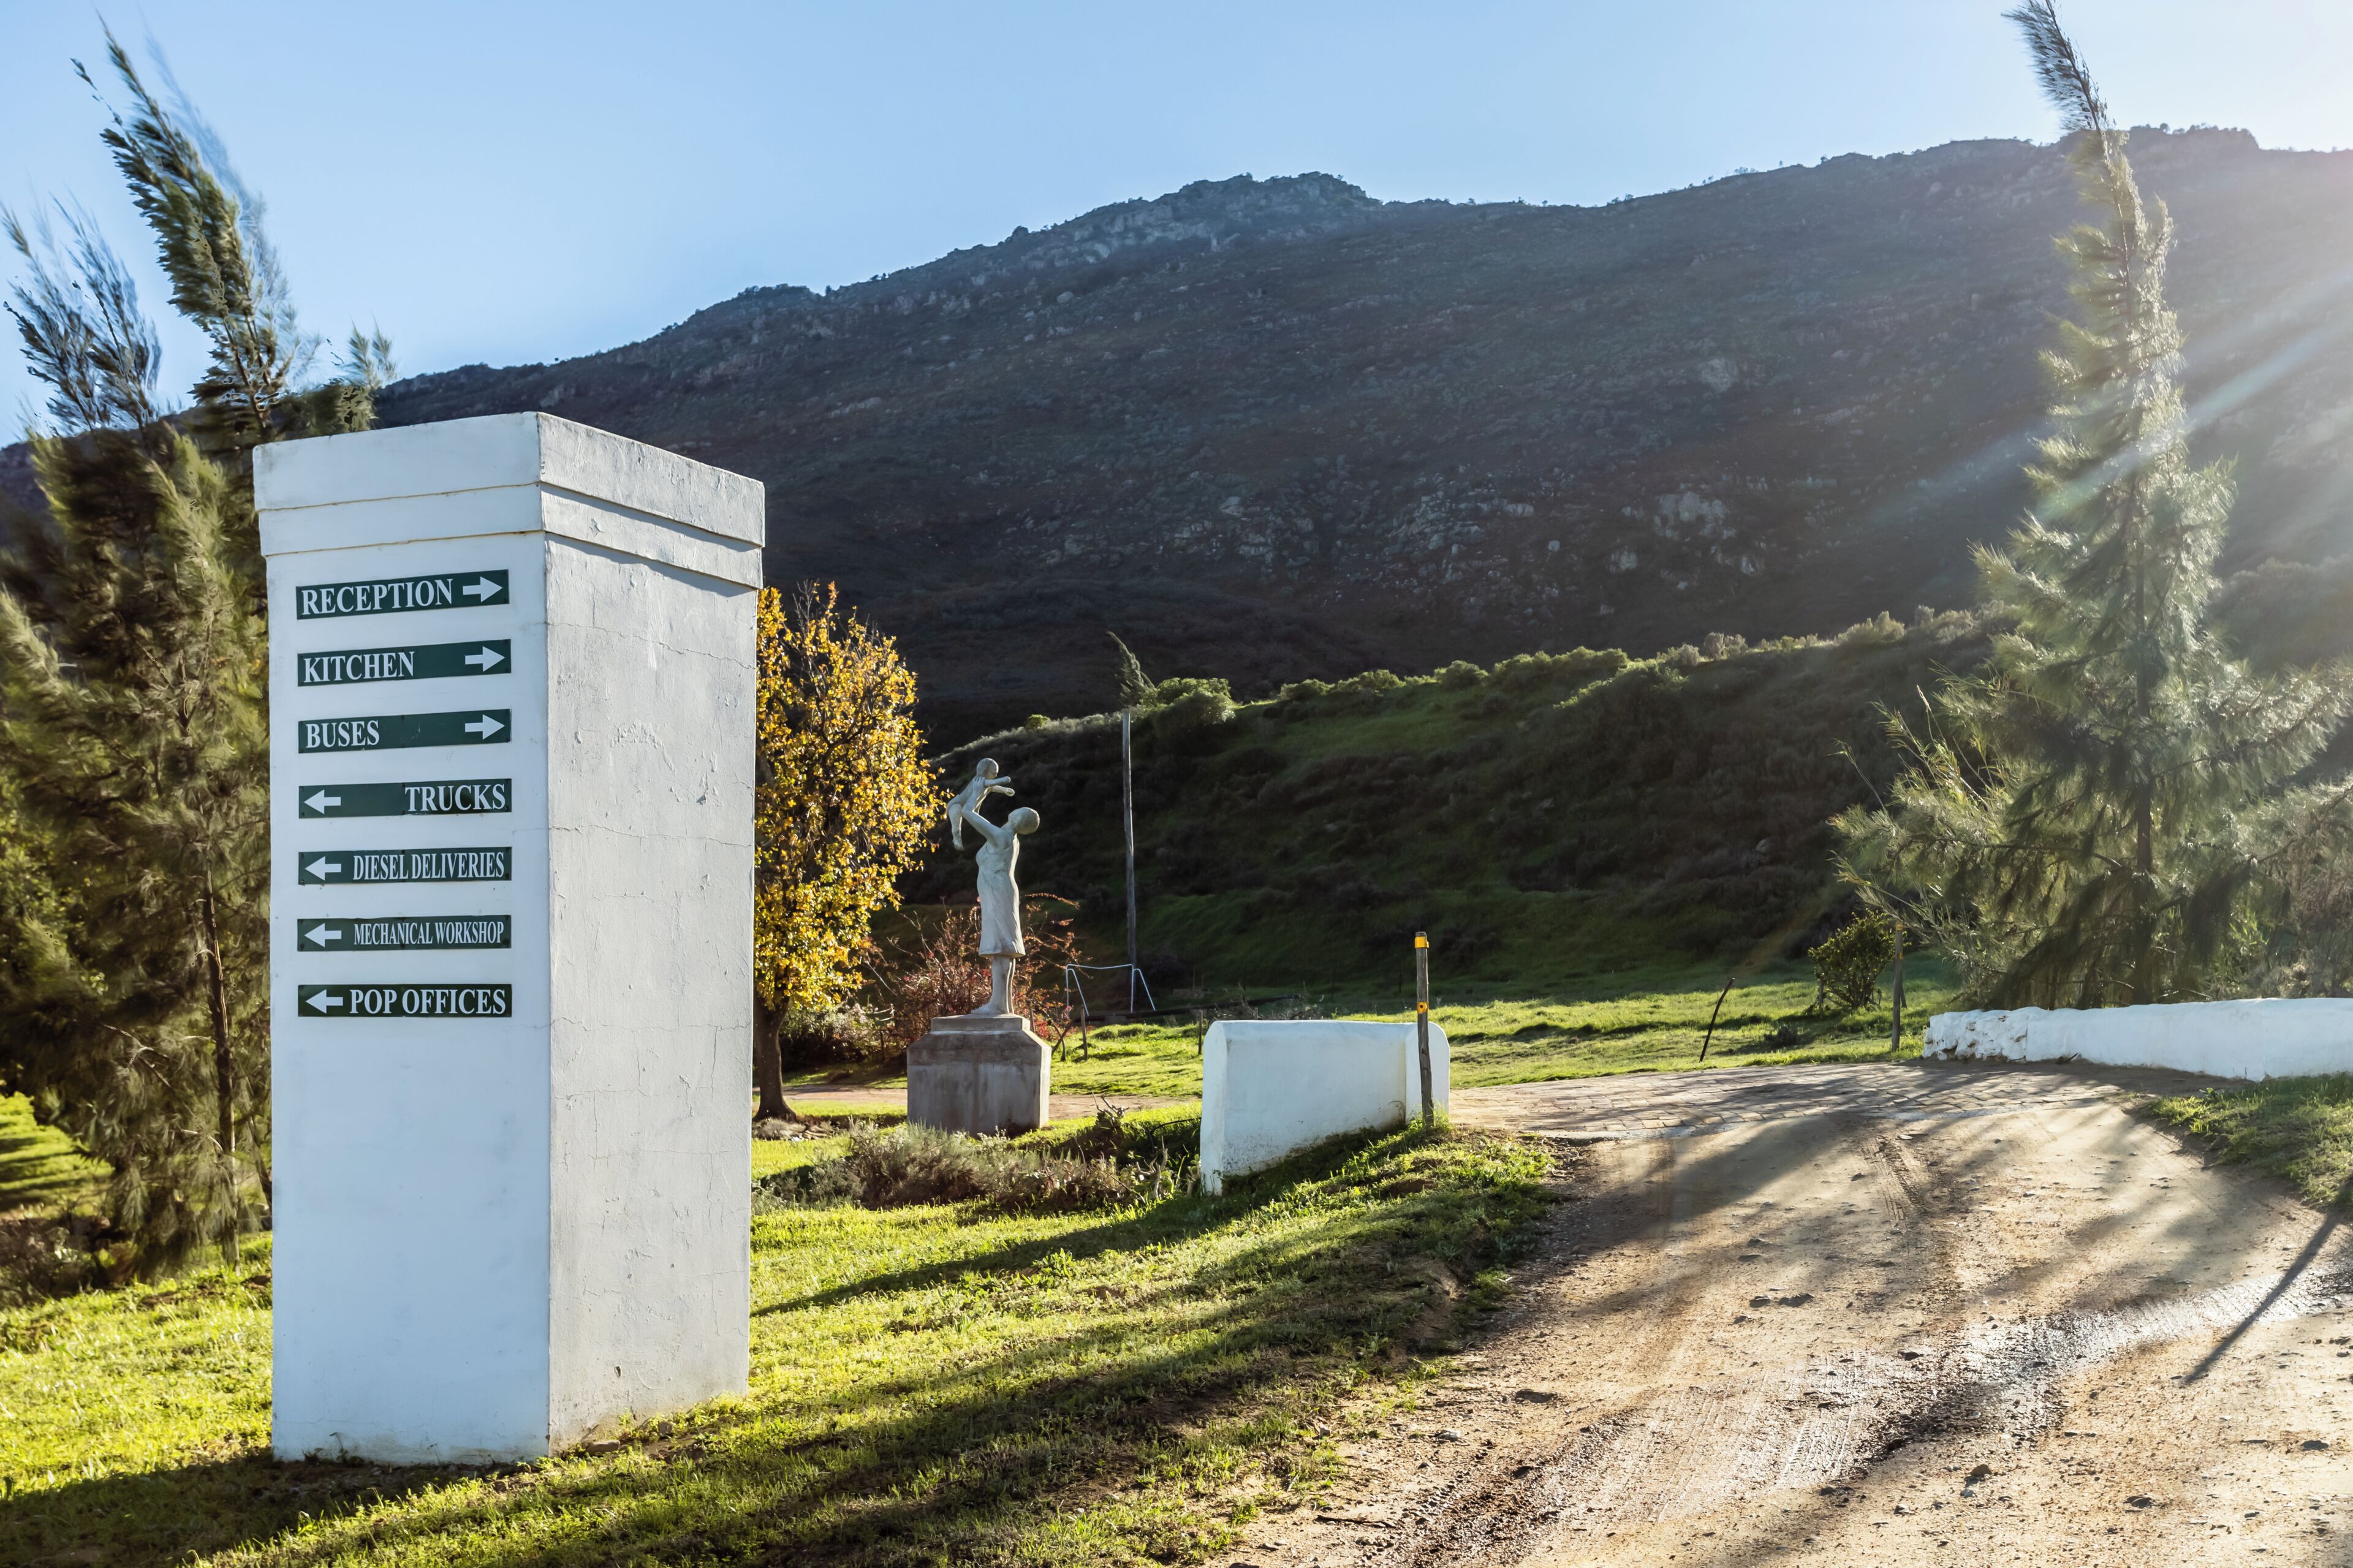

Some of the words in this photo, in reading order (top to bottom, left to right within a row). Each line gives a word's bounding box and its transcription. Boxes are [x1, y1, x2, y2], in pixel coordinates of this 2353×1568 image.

[301, 578, 453, 615] RECEPTION
[303, 651, 415, 683] KITCHEN
[305, 720, 380, 749] BUSES
[404, 784, 506, 812] TRUCKS
[352, 854, 409, 881] DIESEL
[411, 852, 505, 879] DELIVERIES
[354, 922, 433, 945] MECHANICAL
[435, 921, 504, 944] WORKSHOP
[349, 988, 398, 1015] POP
[402, 988, 506, 1015] OFFICES
